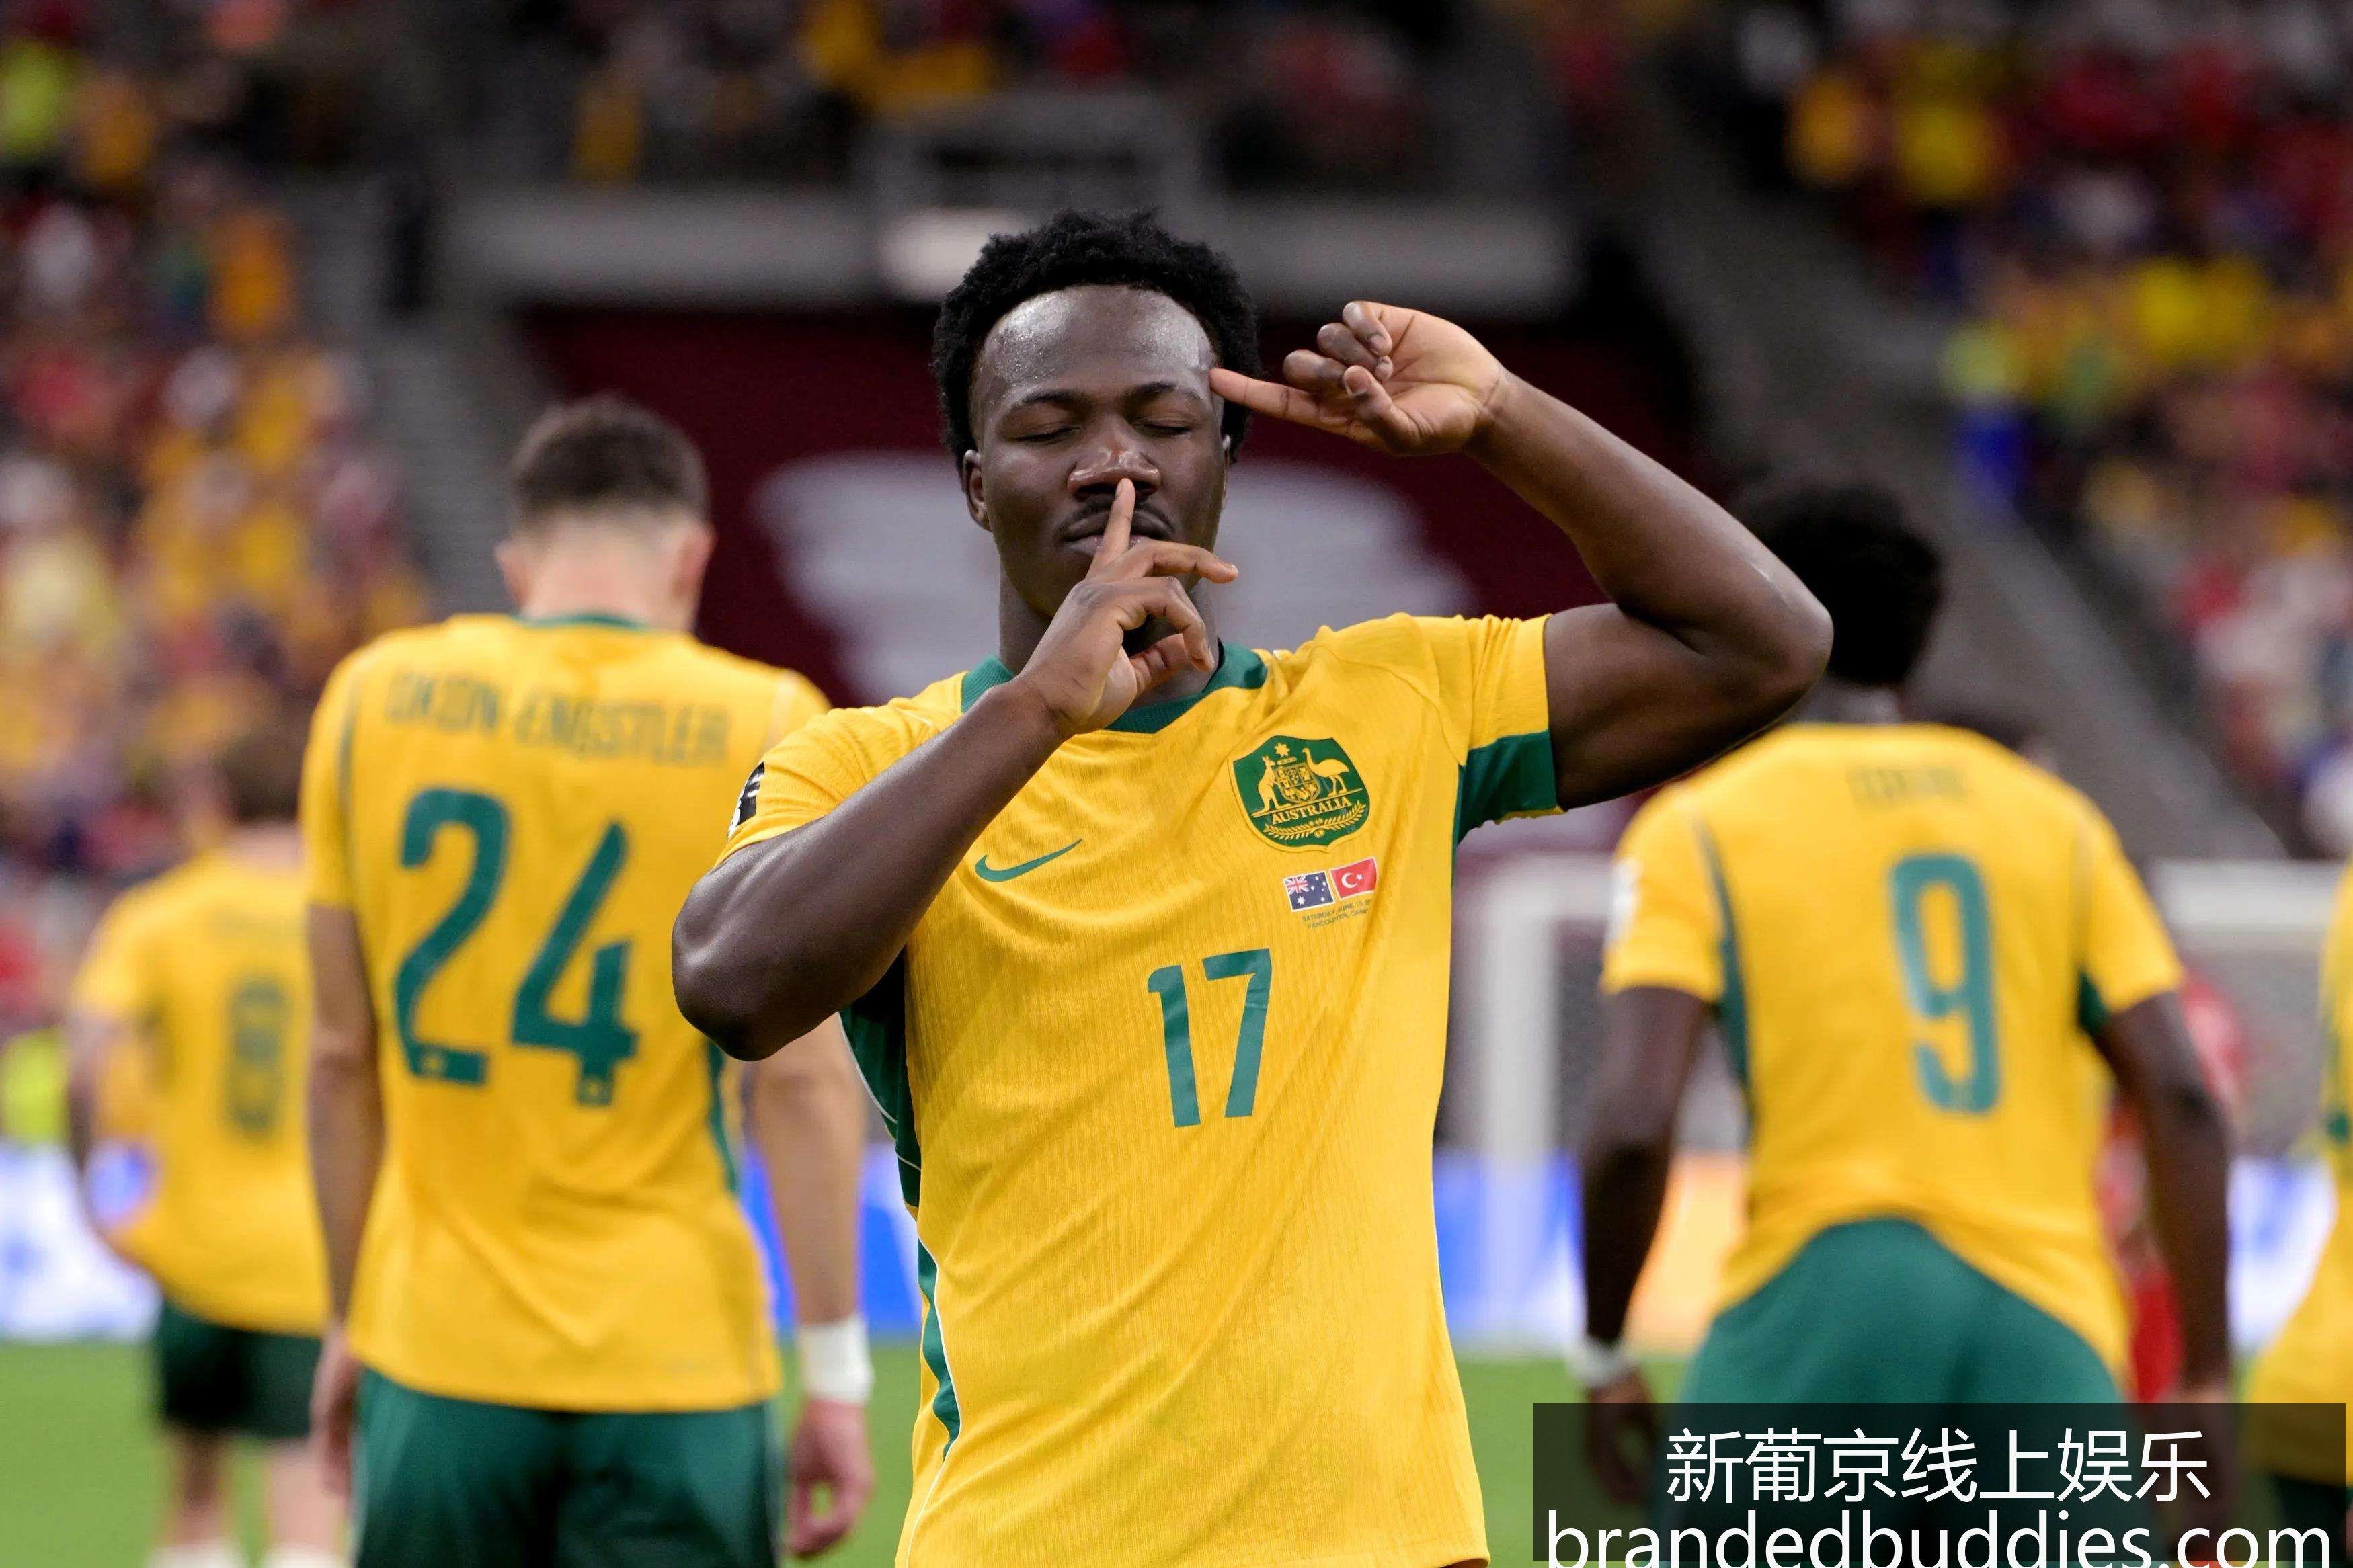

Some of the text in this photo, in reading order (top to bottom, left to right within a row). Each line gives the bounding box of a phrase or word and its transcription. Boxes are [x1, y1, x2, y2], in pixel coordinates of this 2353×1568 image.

[1272, 796, 1353, 825] AUSTRALIA
[395, 785, 639, 1108] 24
[1148, 948, 1272, 1128] 17
[1890, 852, 2001, 1118] 9
